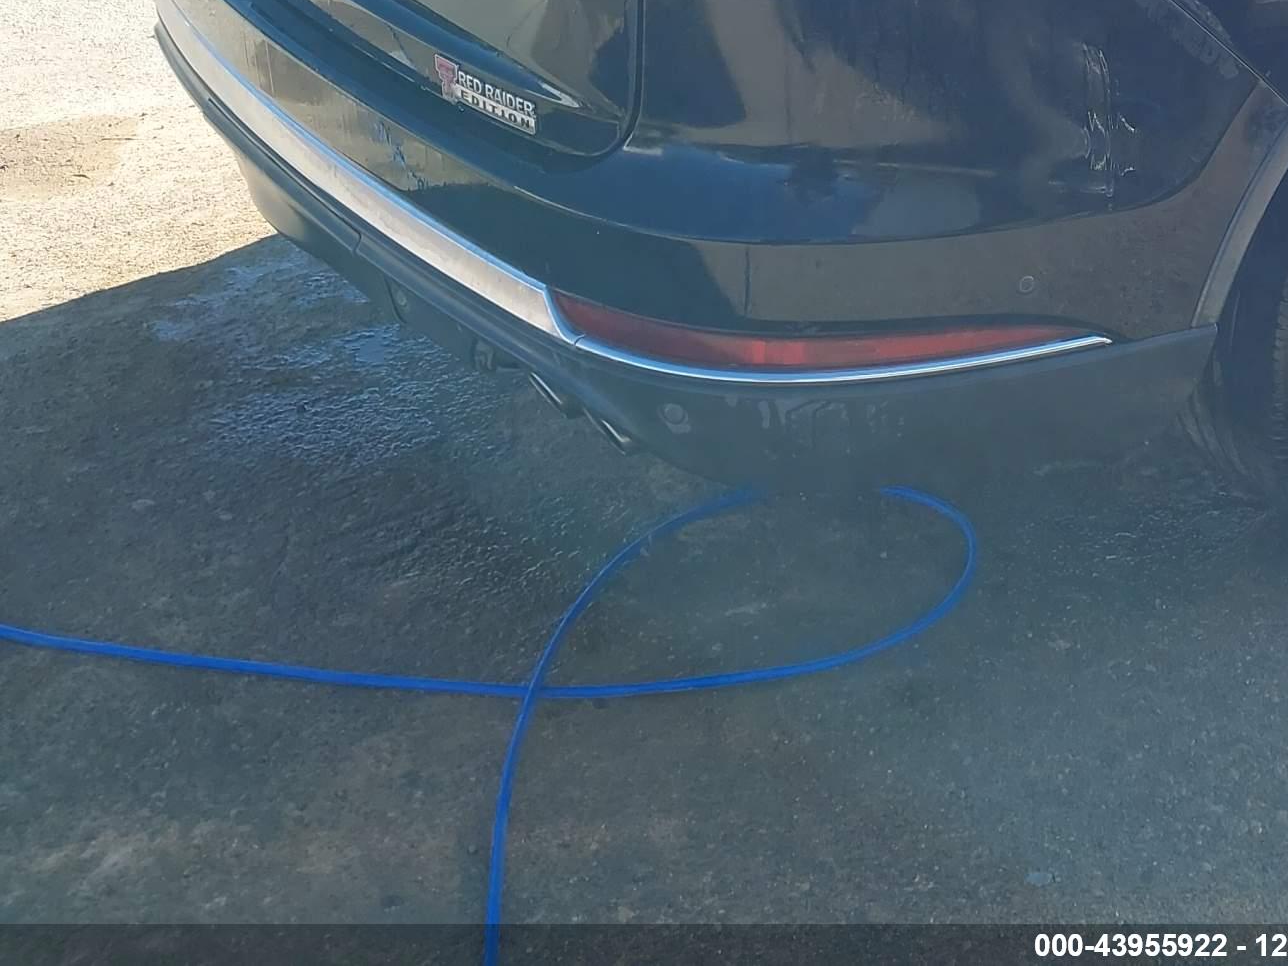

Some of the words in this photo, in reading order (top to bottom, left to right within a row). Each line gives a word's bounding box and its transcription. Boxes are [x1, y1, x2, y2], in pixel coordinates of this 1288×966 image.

[458, 71, 482, 94] RED
[485, 82, 534, 117] RAIDER
[460, 89, 531, 129] EDITION
